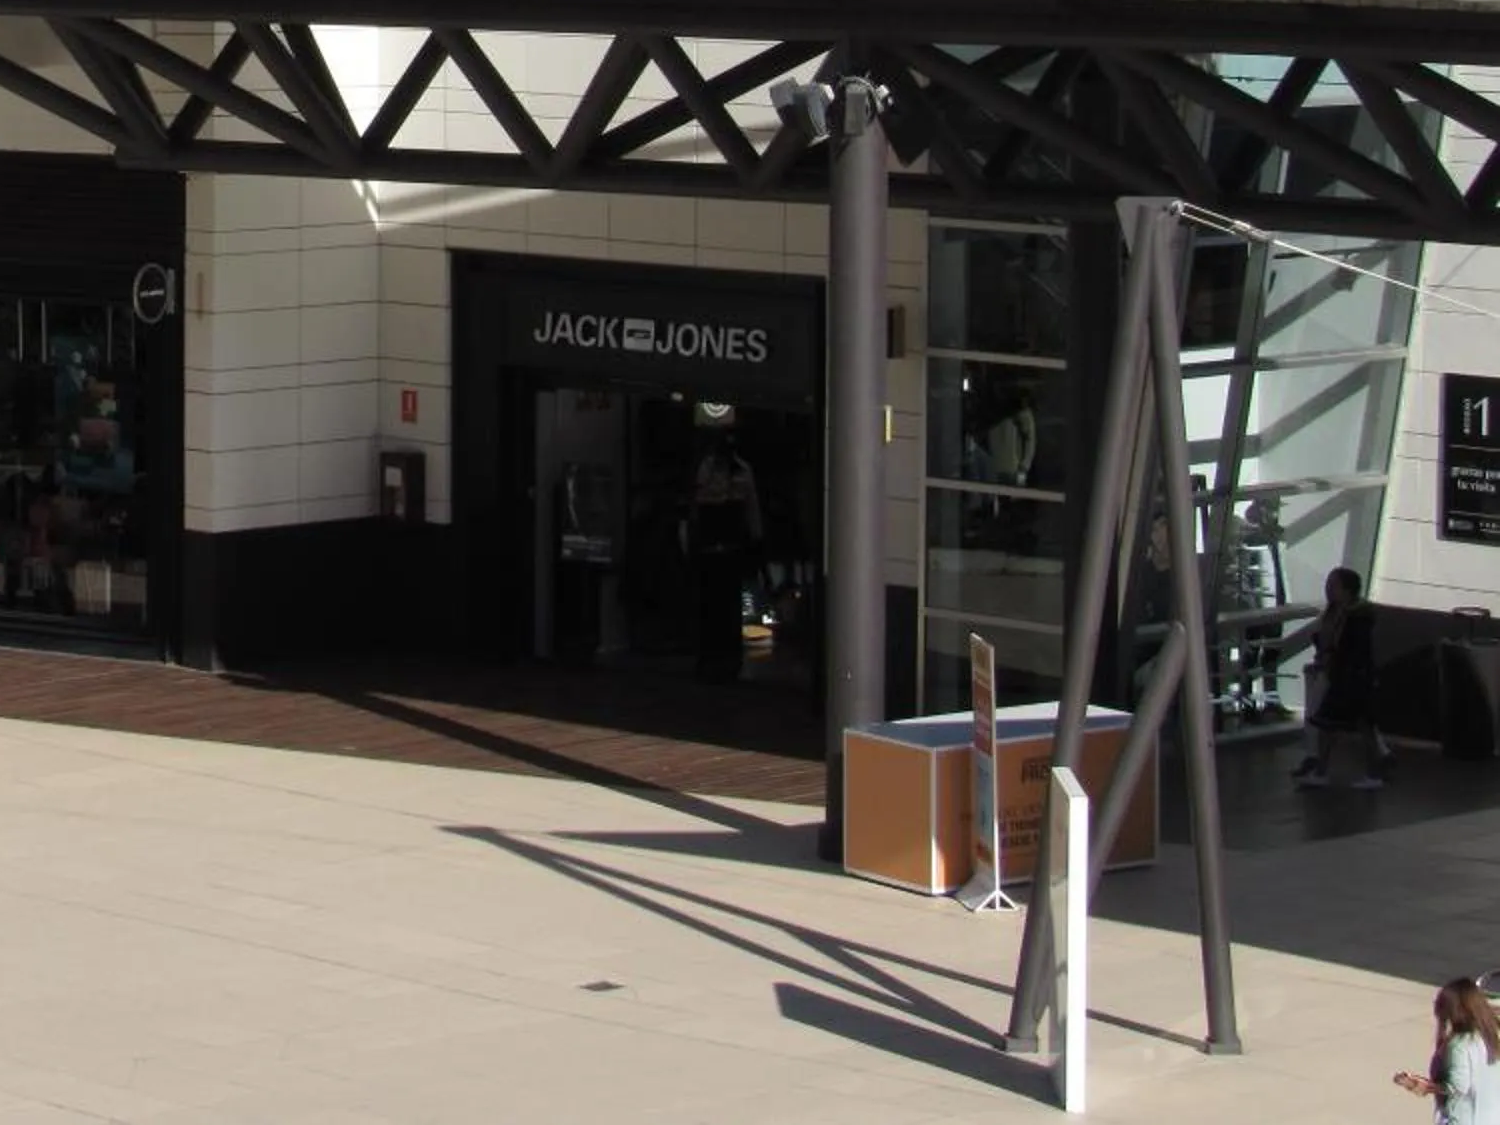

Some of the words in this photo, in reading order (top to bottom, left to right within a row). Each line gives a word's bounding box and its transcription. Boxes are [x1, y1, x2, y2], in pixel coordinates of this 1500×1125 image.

[533, 312, 618, 349] JACK
[656, 323, 768, 363] JONES
[1473, 396, 1491, 437] 1
